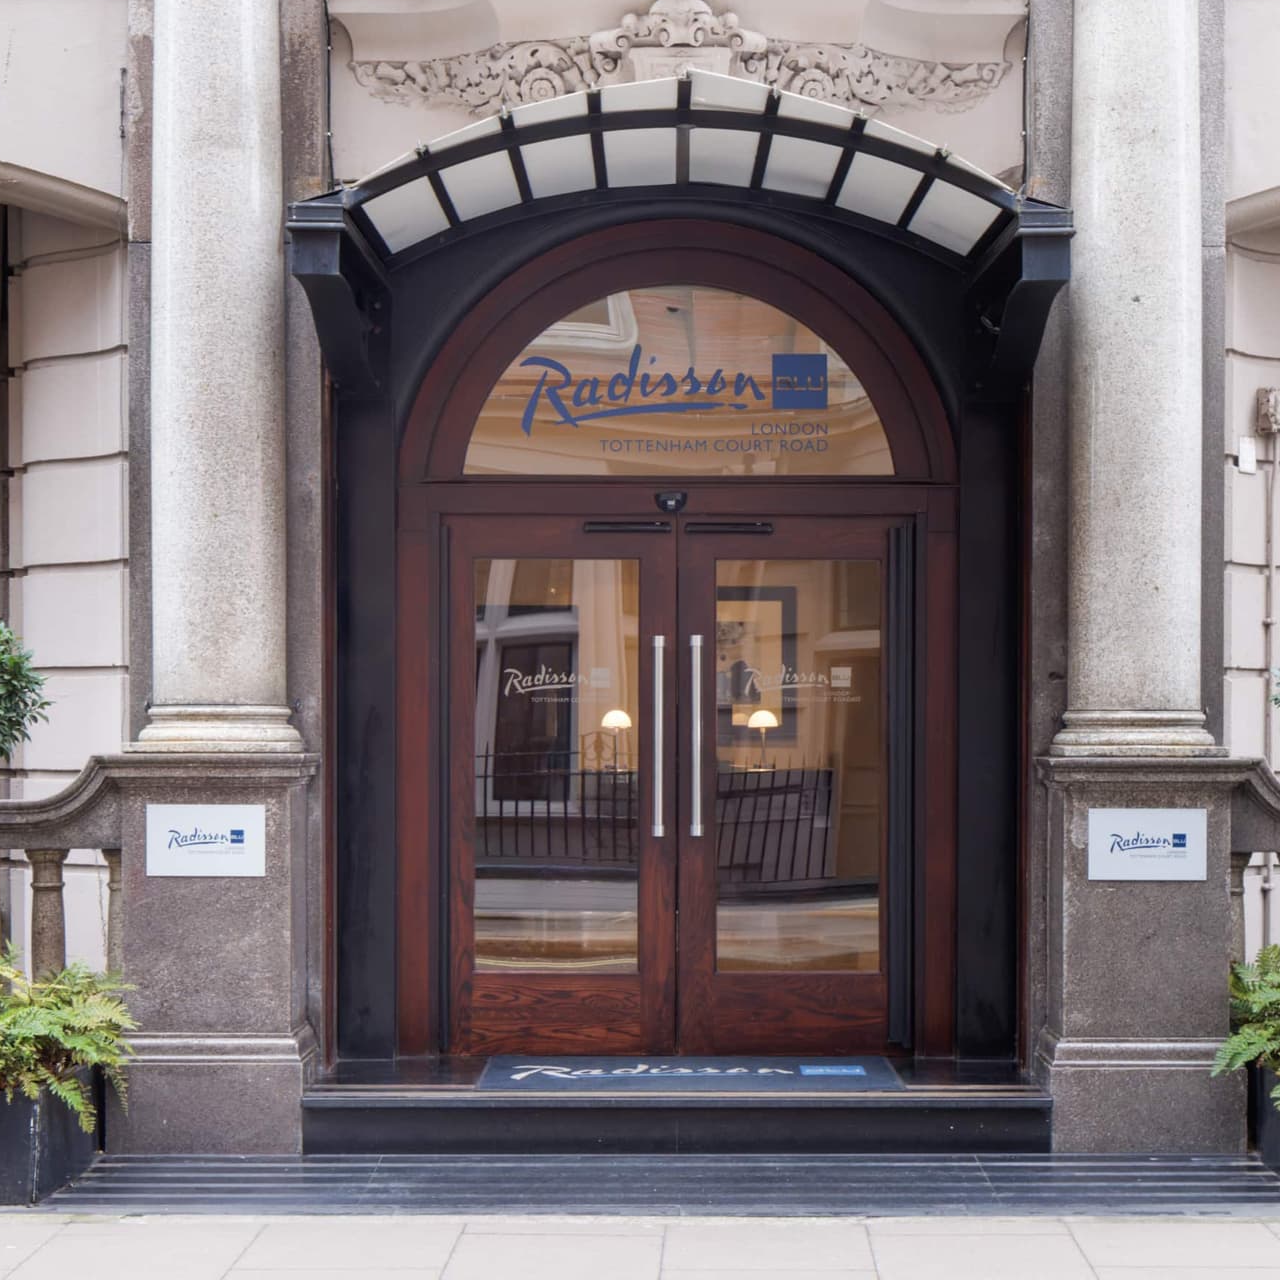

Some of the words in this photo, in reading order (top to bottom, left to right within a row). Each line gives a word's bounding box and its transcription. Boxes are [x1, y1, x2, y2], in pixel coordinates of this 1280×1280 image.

[520, 344, 766, 437] Radisson
[775, 375, 825, 391] BLU
[751, 423, 829, 436] LONDON
[600, 439, 708, 453] TOTTENHAM
[713, 439, 774, 453] COURT
[779, 439, 829, 453] ROAD
[504, 664, 589, 696] Radisson
[168, 827, 229, 849] Radisson
[1110, 832, 1171, 853] Radisson
[510, 1064, 795, 1080] Radisson
